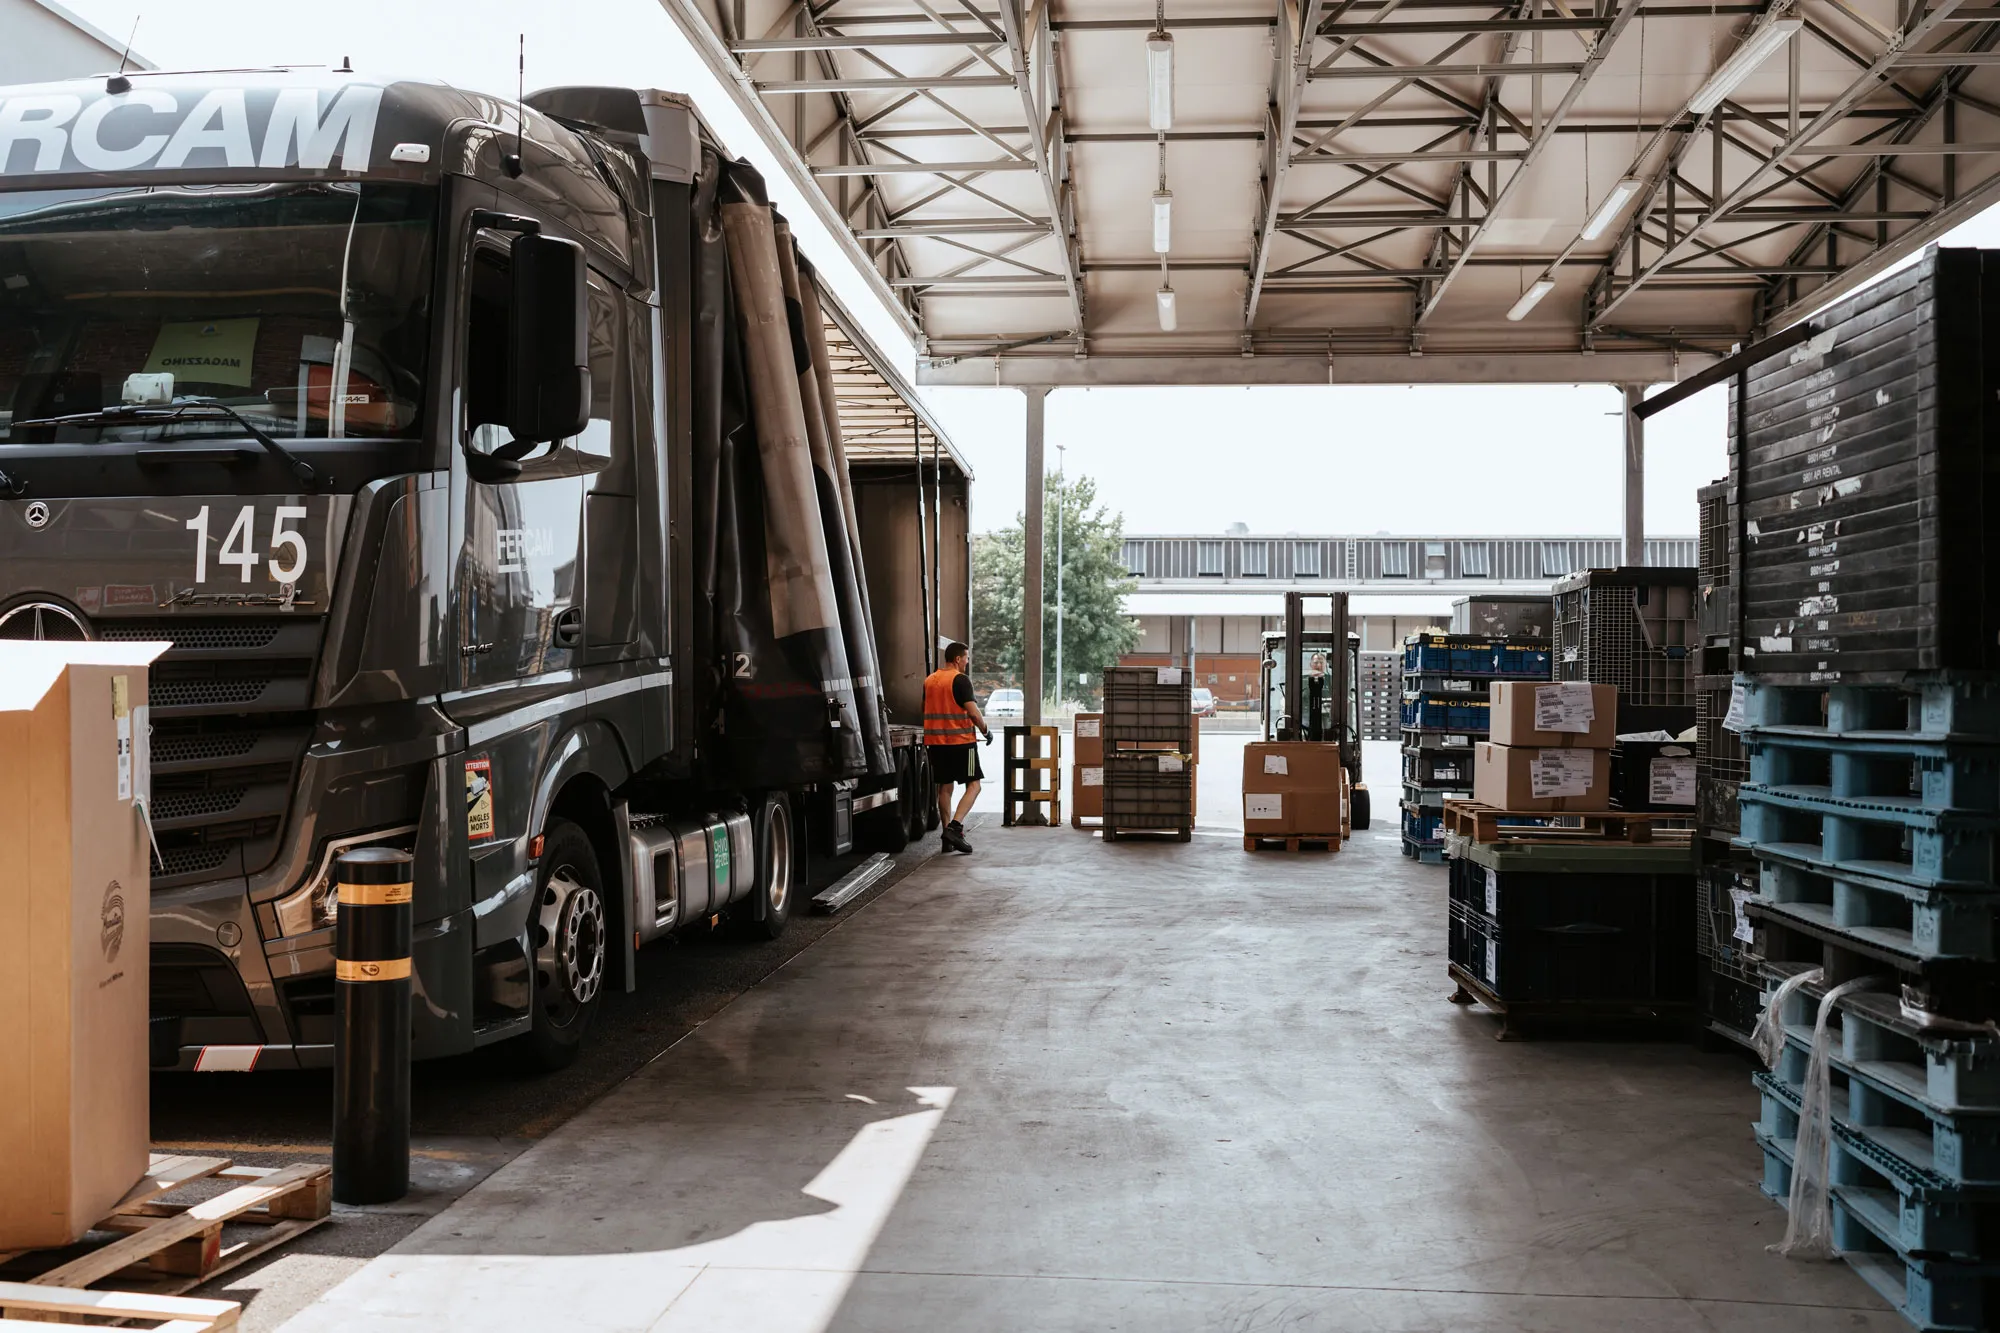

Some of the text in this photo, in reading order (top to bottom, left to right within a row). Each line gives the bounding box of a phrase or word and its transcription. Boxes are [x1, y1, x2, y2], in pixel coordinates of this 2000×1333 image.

[0, 83, 384, 173] RCAM
[1822, 465, 1842, 477] RENTAL
[186, 505, 308, 583] 145
[497, 527, 553, 559] FERCAM
[1818, 582, 1830, 592] 9801
[1817, 620, 1829, 631] 9801
[735, 653, 751, 677] 2
[469, 813, 490, 823] ANGLES
[470, 822, 490, 832] MORTS
